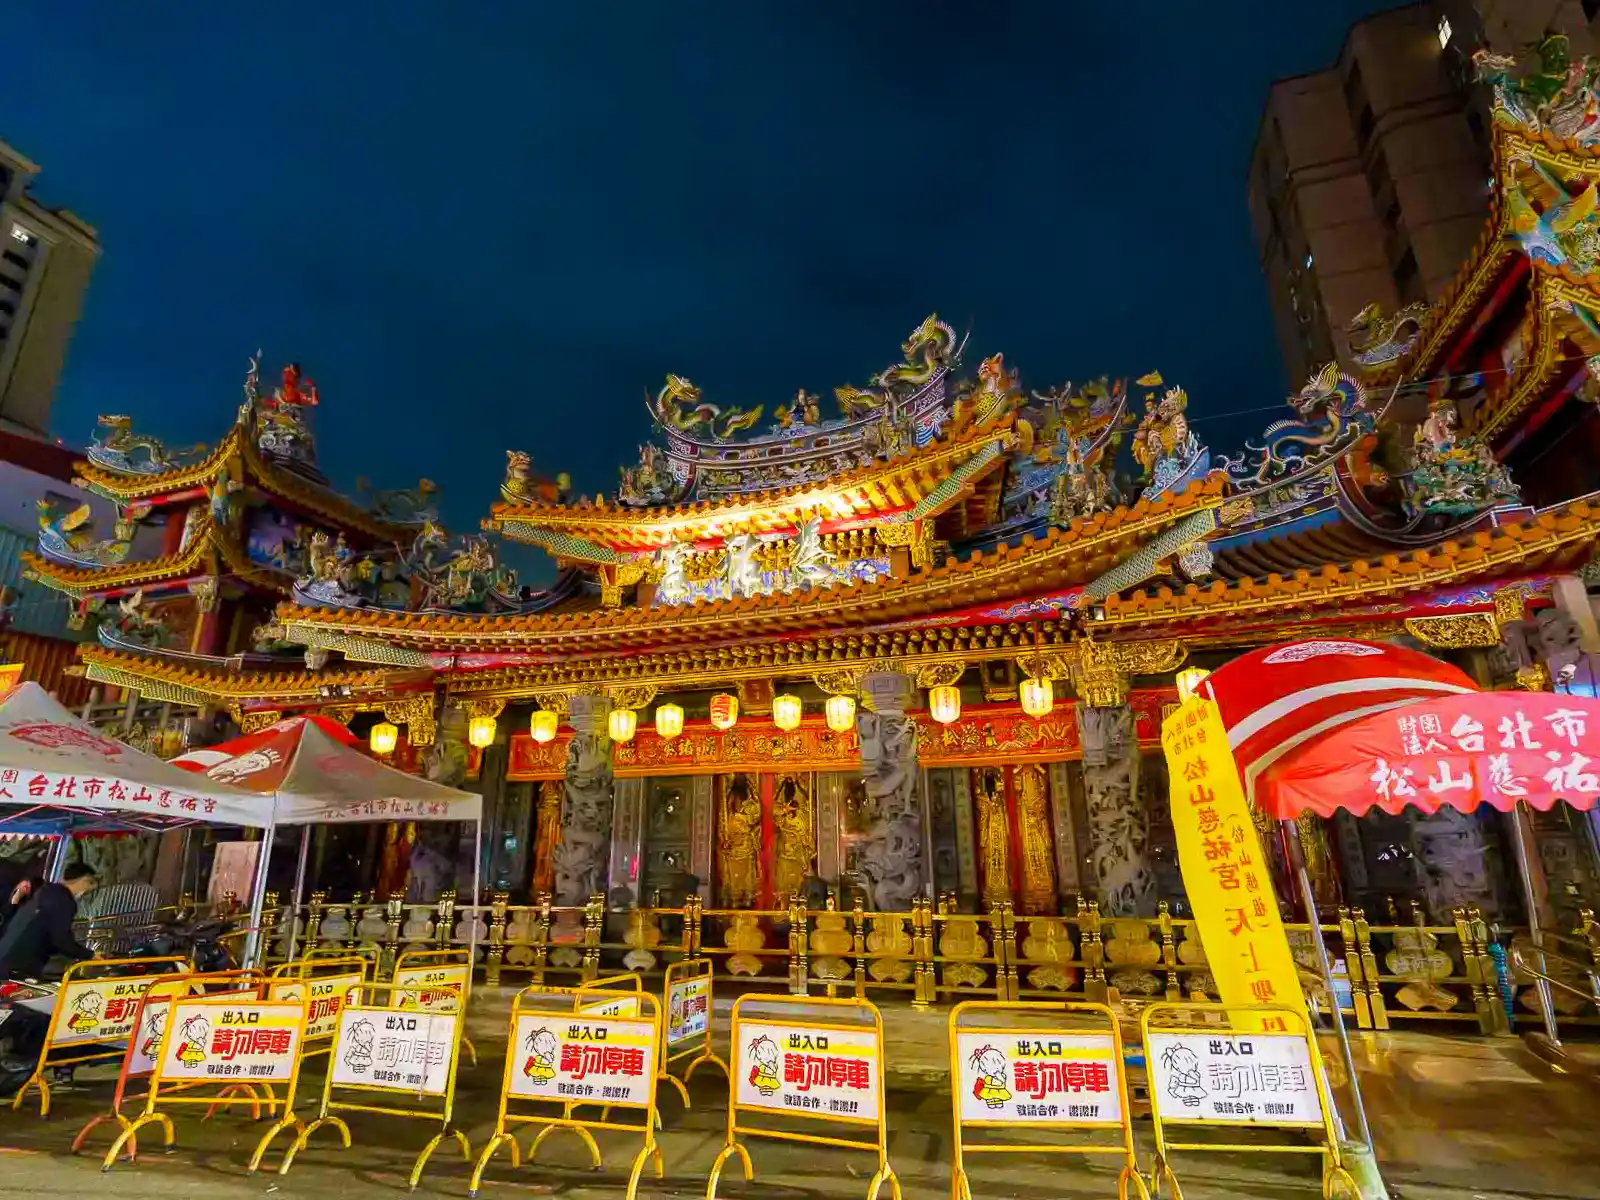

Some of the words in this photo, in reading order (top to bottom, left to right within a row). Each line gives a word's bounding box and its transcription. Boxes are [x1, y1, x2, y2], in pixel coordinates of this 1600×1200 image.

[114, 983, 149, 995] 出入口
[222, 1011, 260, 1025] 出入口
[385, 1016, 417, 1031] 出入口
[567, 1024, 608, 1040] 出入口
[211, 1028, 292, 1061] 請勿停車
[789, 1034, 828, 1050] 出入口
[1017, 1040, 1063, 1057] 出入口
[1209, 1040, 1253, 1056] 出入口
[560, 1043, 645, 1081] 請勿停車
[784, 1052, 870, 1092] 請勿停車
[1013, 1061, 1110, 1100] 請勿停車
